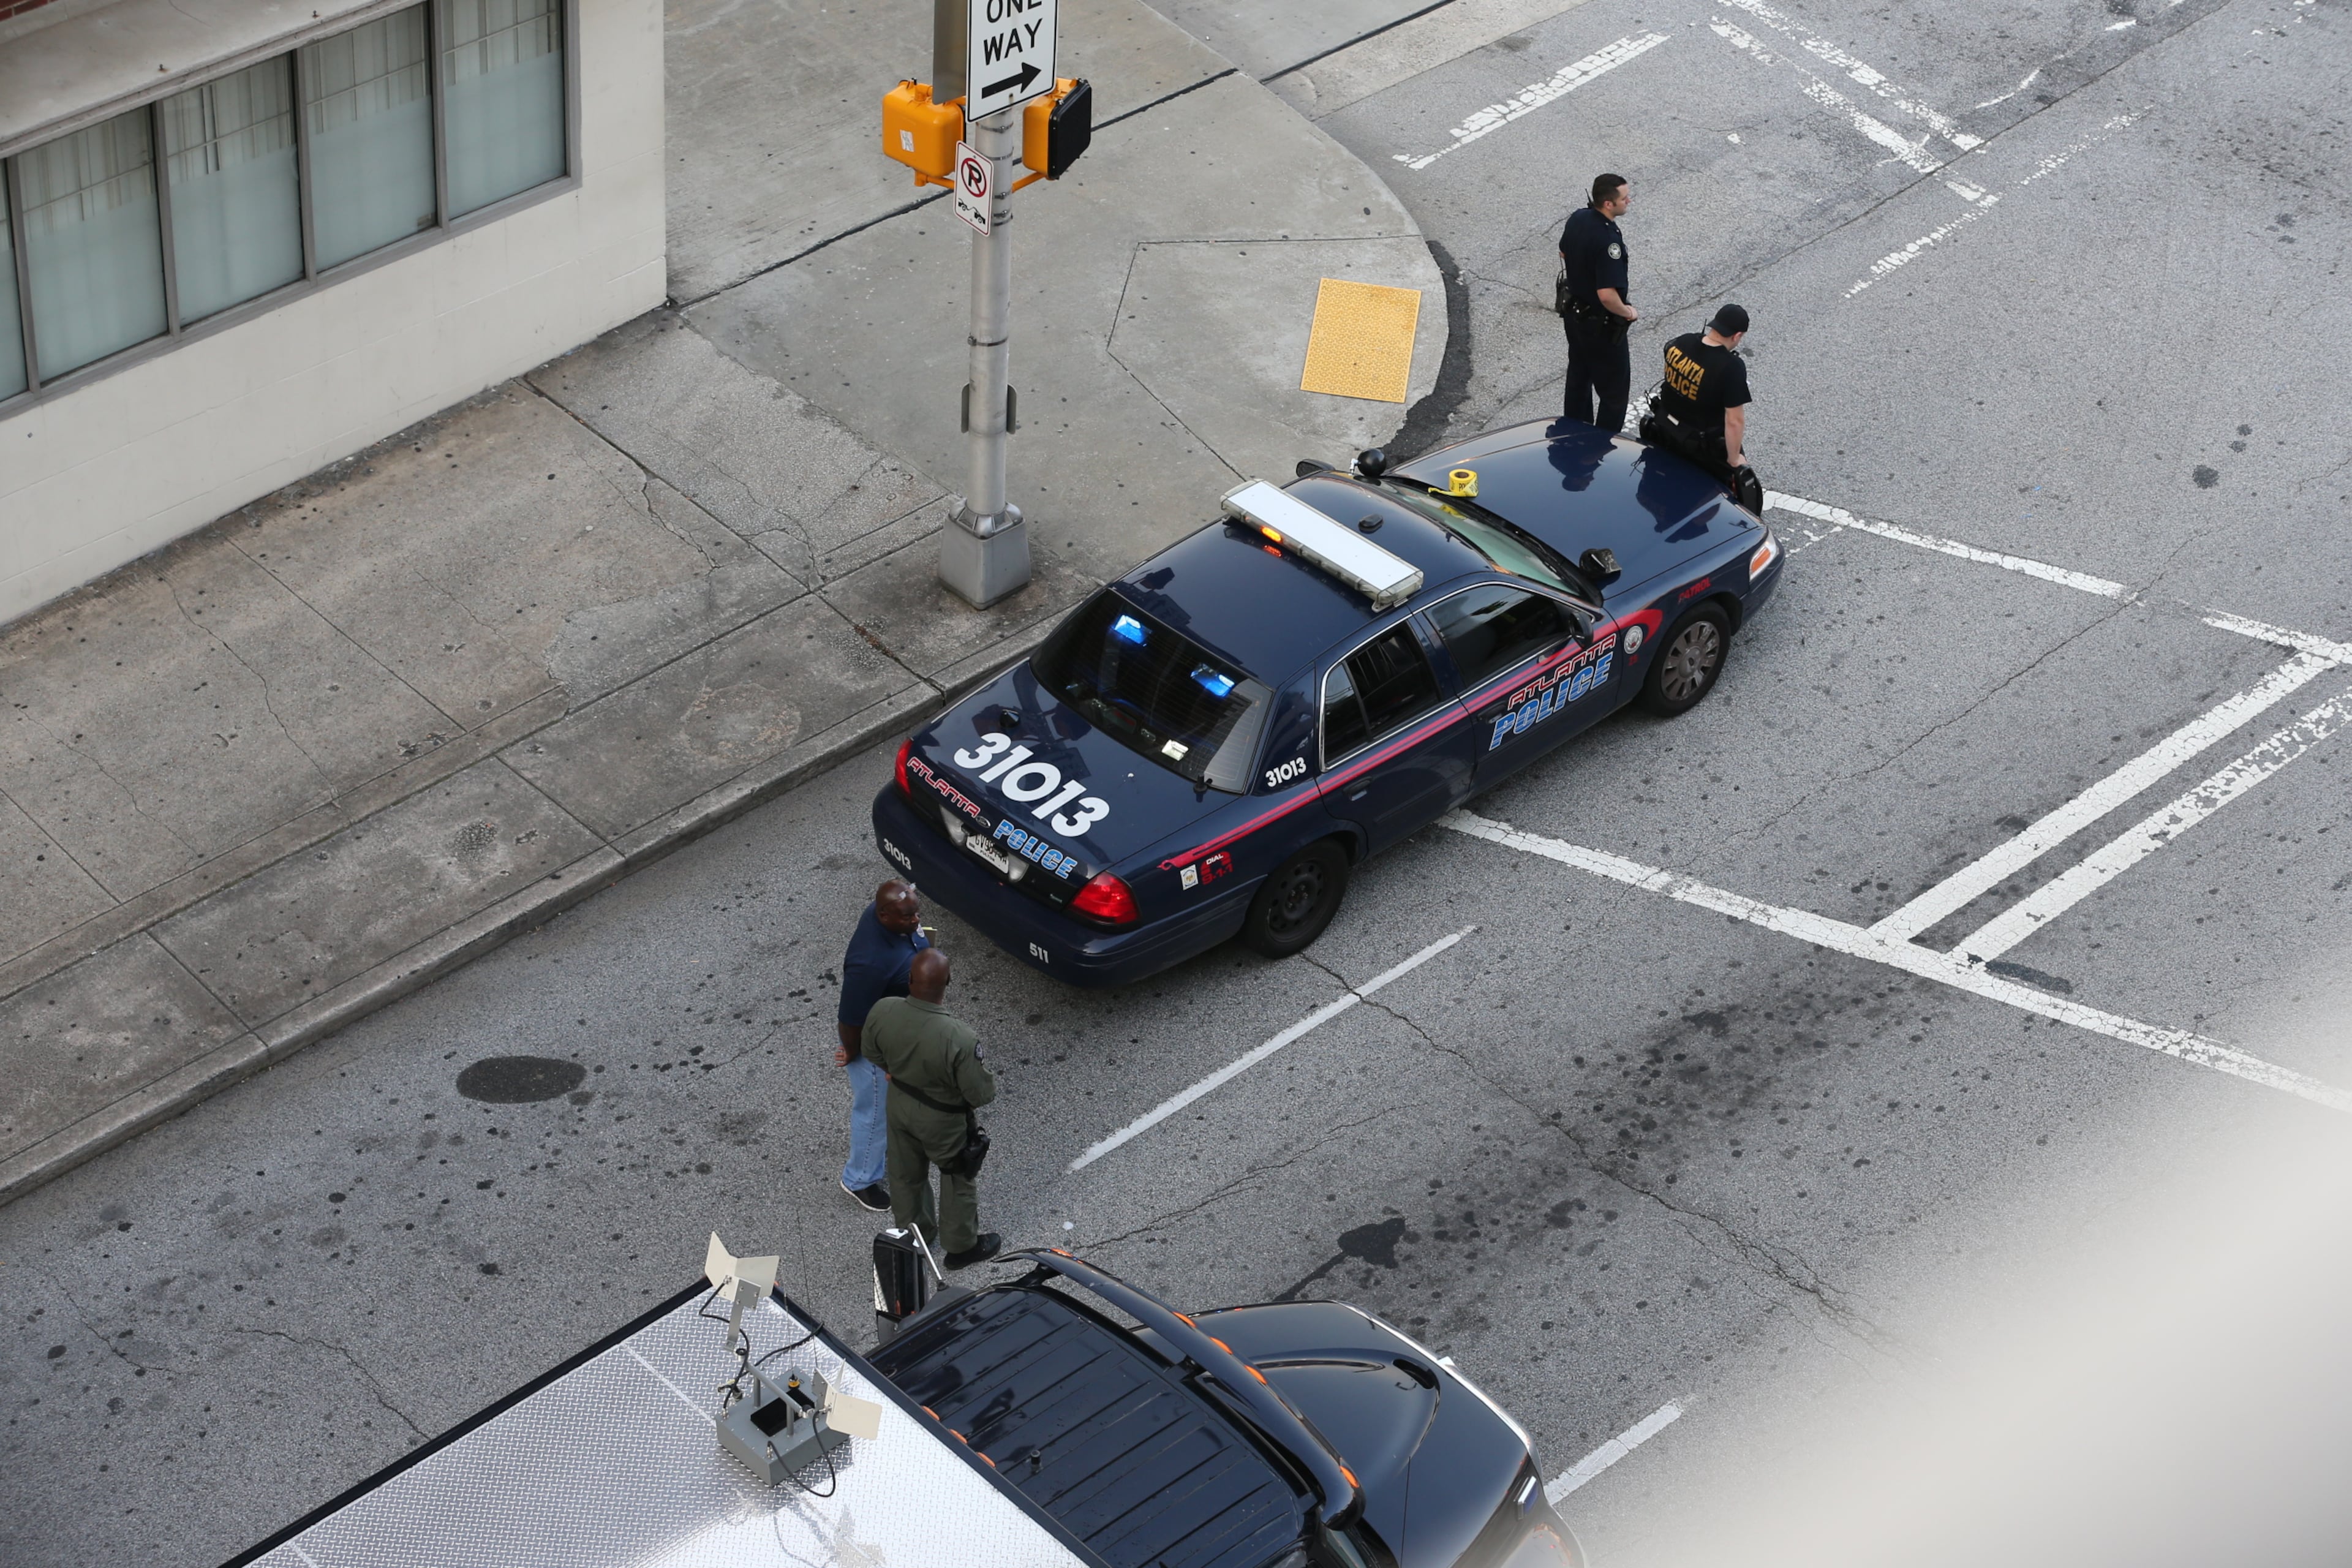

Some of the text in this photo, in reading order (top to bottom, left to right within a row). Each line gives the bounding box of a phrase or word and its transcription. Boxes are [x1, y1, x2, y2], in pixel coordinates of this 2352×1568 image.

[984, 18, 1042, 66] WAY
[1667, 346, 1705, 385] ATLANTA
[1678, 578, 1711, 605] PATROL
[1507, 633, 1616, 710] ATLANTA
[1489, 651, 1613, 751] POLICE
[954, 733, 1110, 837] 31013
[1265, 756, 1306, 787] 31013
[907, 756, 1078, 879] ATLANTA POLICE
[884, 838, 911, 870] 31013
[1206, 853, 1224, 865] DIAL
[1029, 942, 1049, 963] 511
